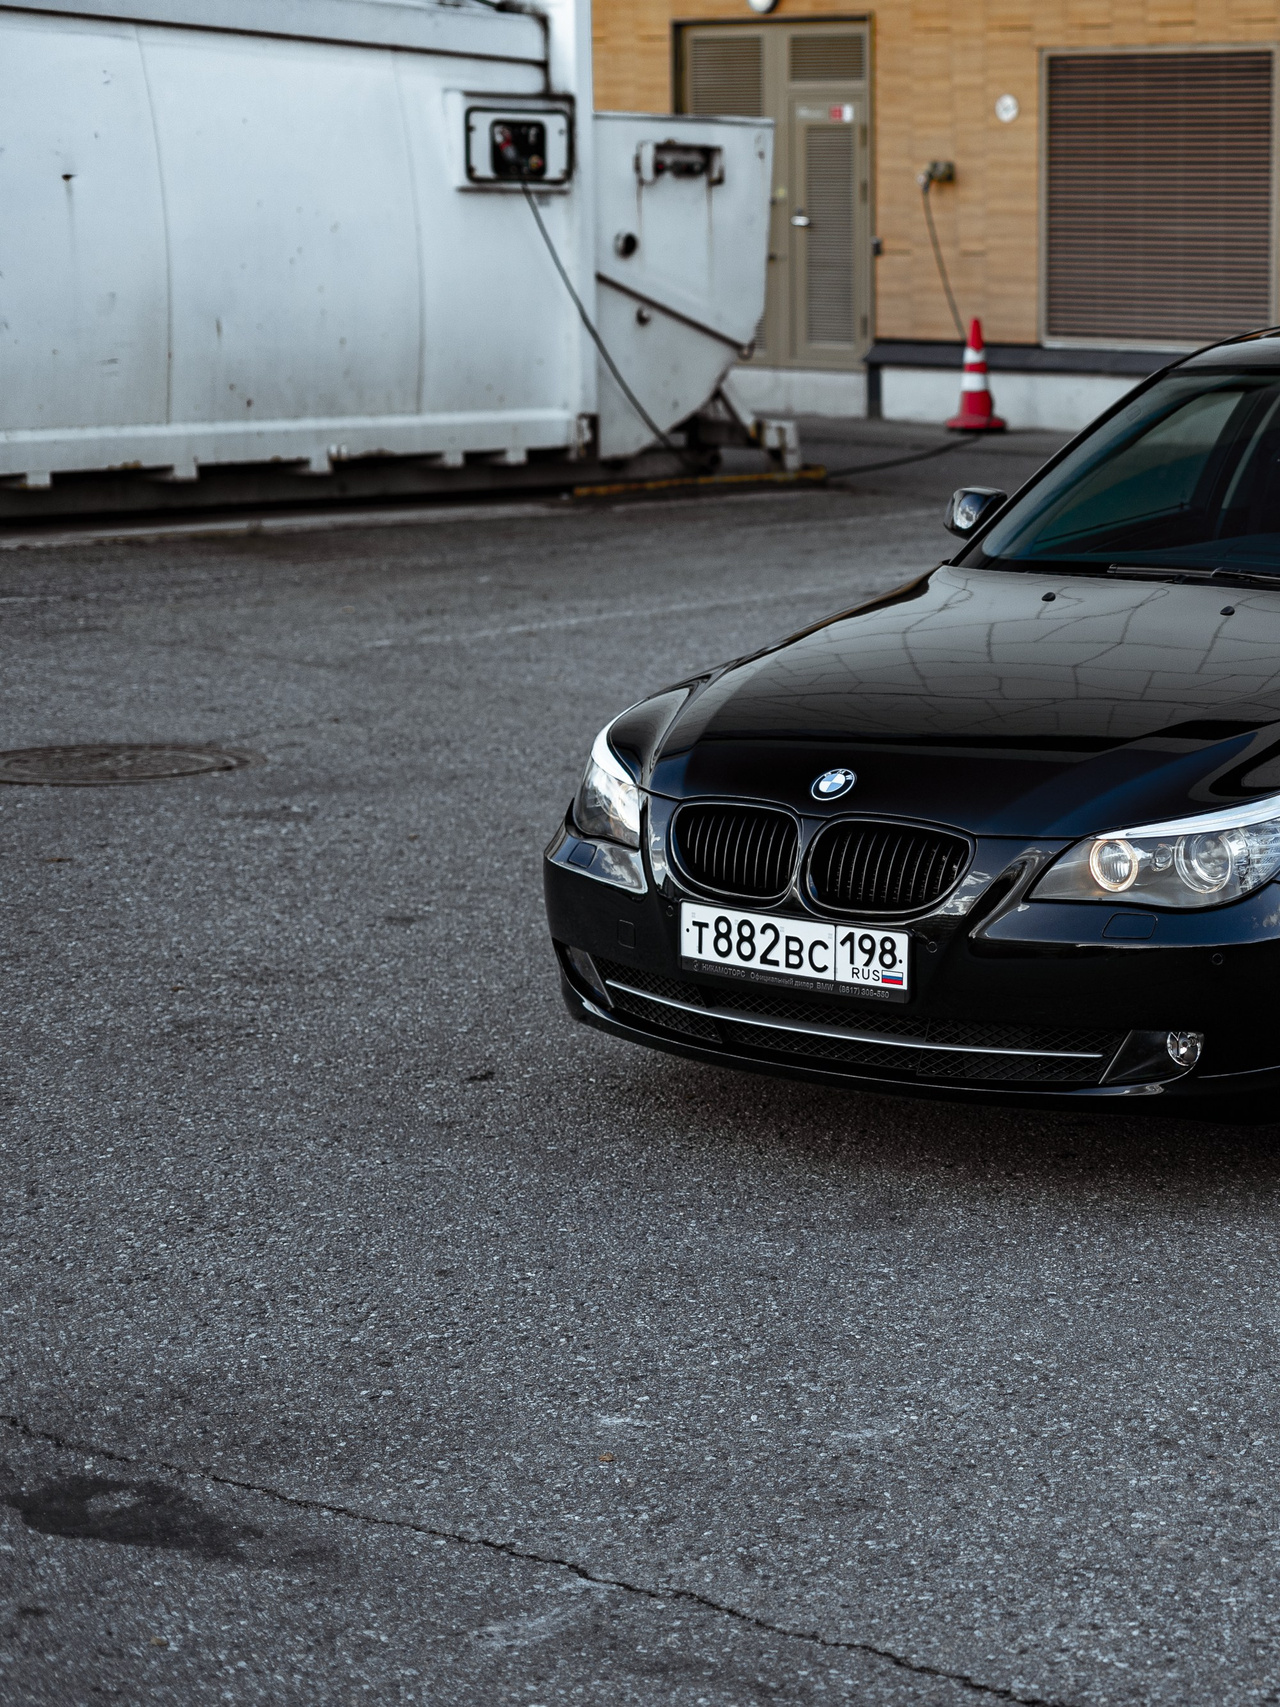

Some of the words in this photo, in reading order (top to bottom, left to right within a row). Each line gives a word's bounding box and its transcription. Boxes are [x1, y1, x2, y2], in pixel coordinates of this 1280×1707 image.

[839, 931, 897, 969] 198
[702, 963, 746, 978] НИКАМОТОРС
[750, 971, 794, 986] Официальный
[794, 979, 814, 990] дилер
[816, 981, 834, 992] BMW
[851, 967, 881, 982] RUS
